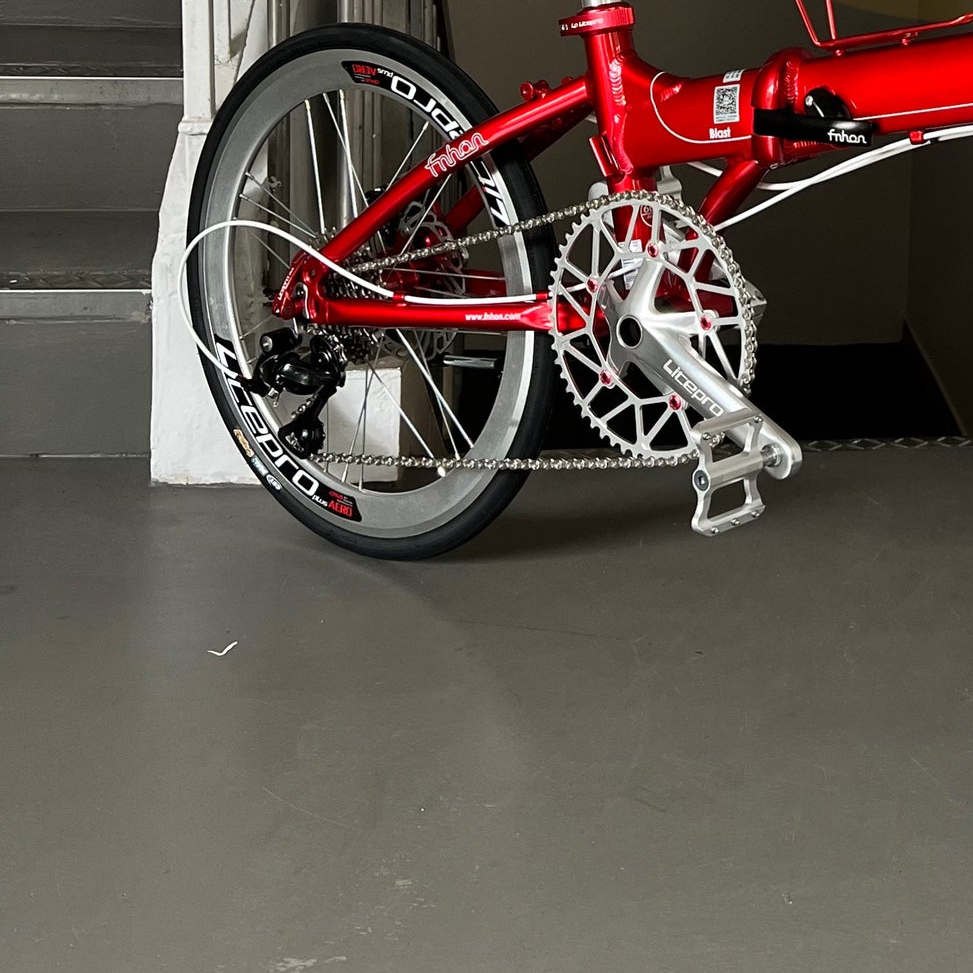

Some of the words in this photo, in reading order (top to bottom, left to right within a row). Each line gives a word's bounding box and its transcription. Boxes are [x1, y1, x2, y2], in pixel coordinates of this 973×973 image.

[709, 127, 731, 139] Blast
[827, 128, 867, 144] fnhon
[425, 132, 486, 177] fnhon
[465, 312, 522, 320] www.fnhon.com
[662, 358, 723, 417] Litepro
[214, 338, 319, 498] Ltepro
[328, 500, 353, 517] AERO
